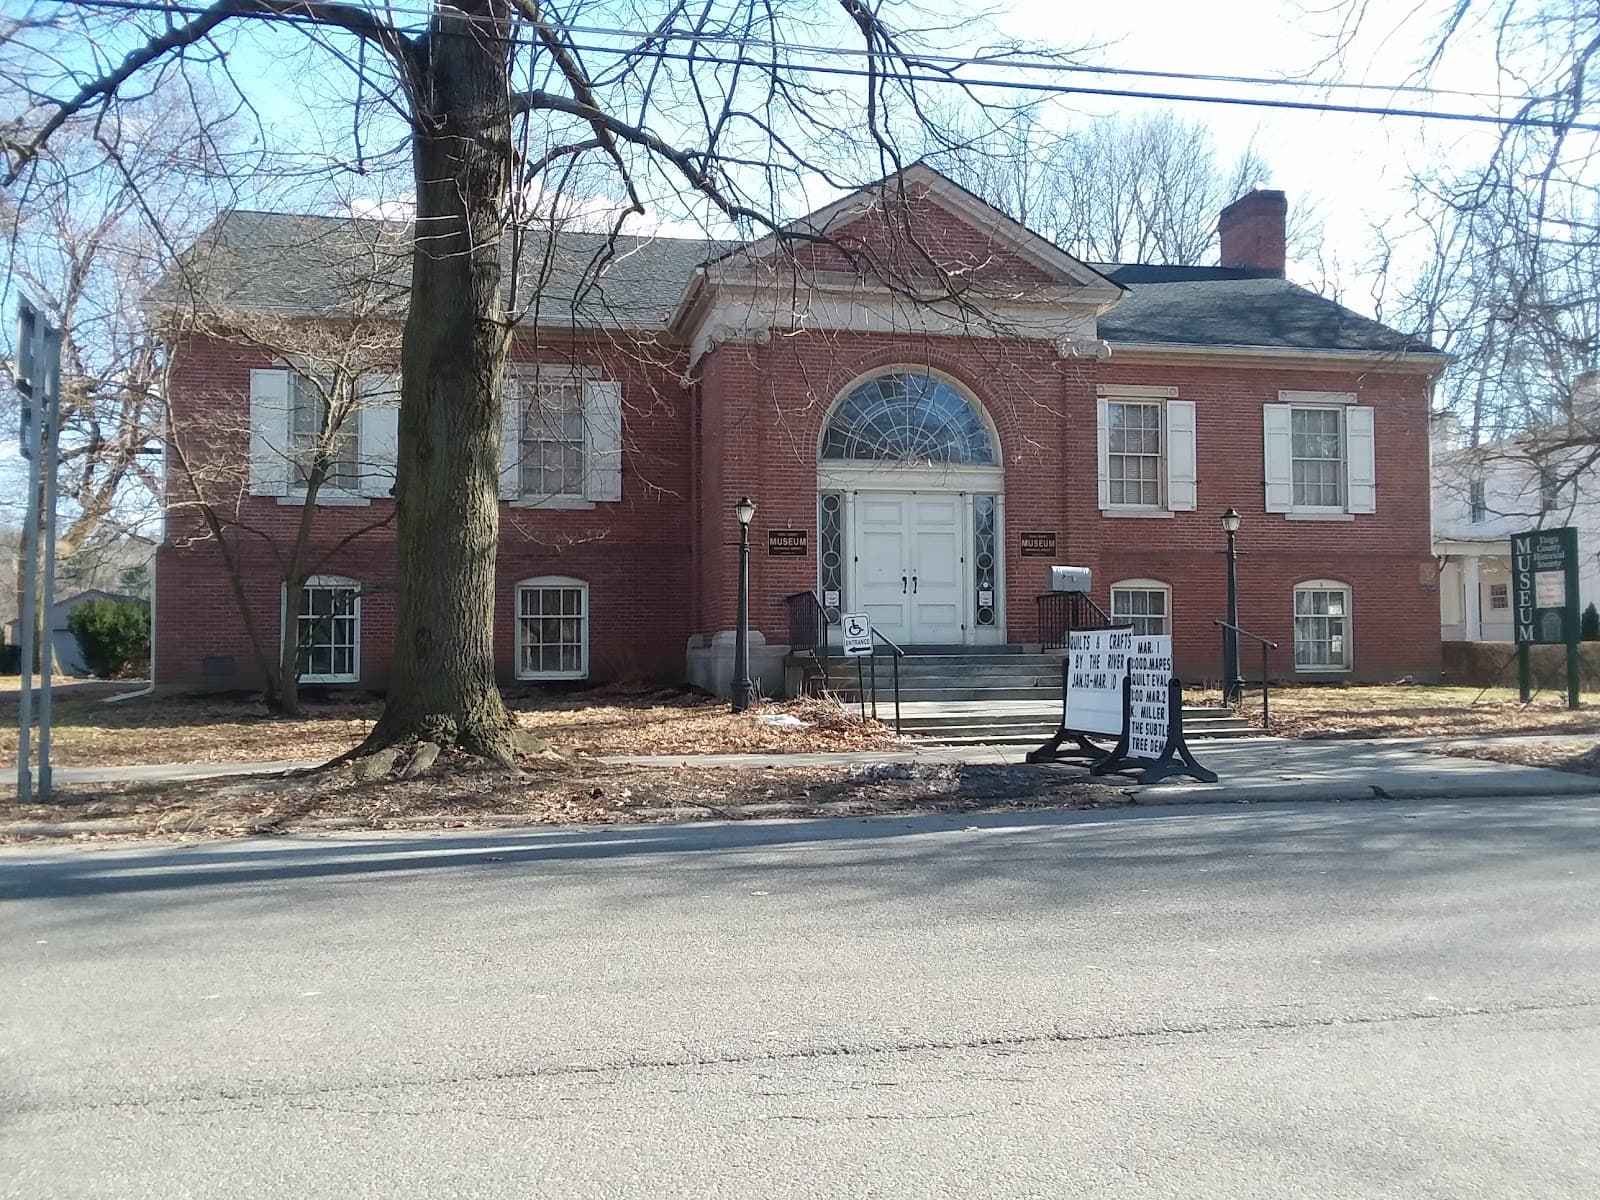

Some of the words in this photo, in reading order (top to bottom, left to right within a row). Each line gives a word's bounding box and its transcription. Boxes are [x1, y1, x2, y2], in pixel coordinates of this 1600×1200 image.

[769, 537, 807, 546] MUSEUM
[1021, 539, 1055, 548] MUSEUM
[1515, 537, 1535, 641] MUSEUM
[845, 638, 871, 647] ENTRANCE
[1070, 635, 1090, 651] QUILTS
[1109, 632, 1132, 650] CRAFTS
[1156, 641, 1160, 654] 1
[1075, 654, 1083, 670] BY
[1089, 654, 1101, 670] THE
[1107, 653, 1125, 670] RIVER
[1132, 673, 1150, 687] QUILT
[1140, 706, 1165, 721] MILLER
[1131, 721, 1143, 735] THE
[1132, 737, 1148, 751] TREE
